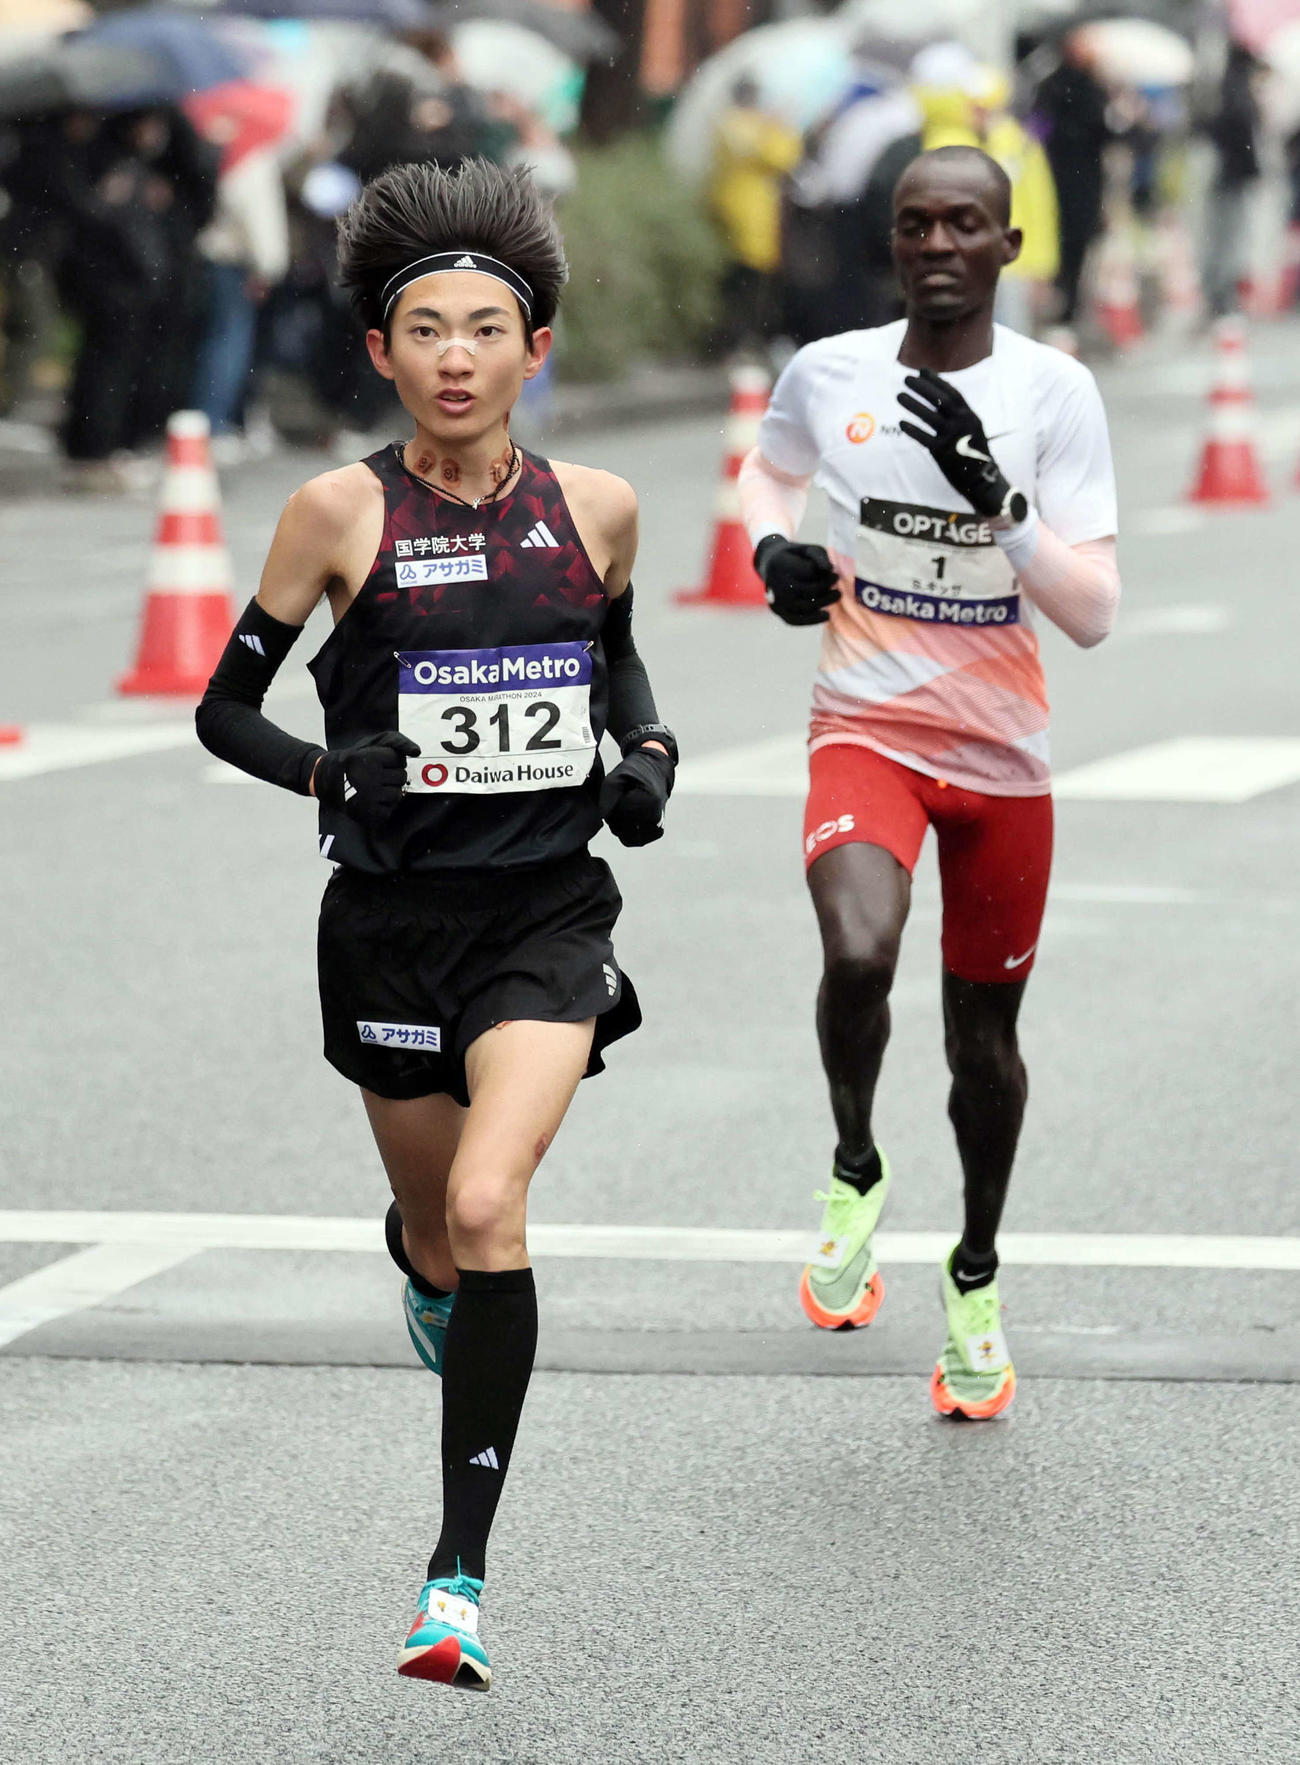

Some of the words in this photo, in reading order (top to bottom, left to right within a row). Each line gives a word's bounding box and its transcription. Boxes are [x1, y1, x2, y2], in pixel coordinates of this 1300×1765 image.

[893, 512, 992, 543] OPTAGE
[395, 533, 486, 557] 国学院大学
[423, 559, 484, 578] アサガミ
[931, 556, 946, 579] 1
[861, 586, 935, 620] Osaka
[938, 600, 1008, 623] Metro
[459, 695, 487, 703] OSAKA
[523, 691, 542, 699] 2024
[440, 701, 562, 755] 312
[455, 766, 514, 784] Daiwa
[517, 764, 574, 781] House
[382, 1028, 438, 1046] アサガミ
